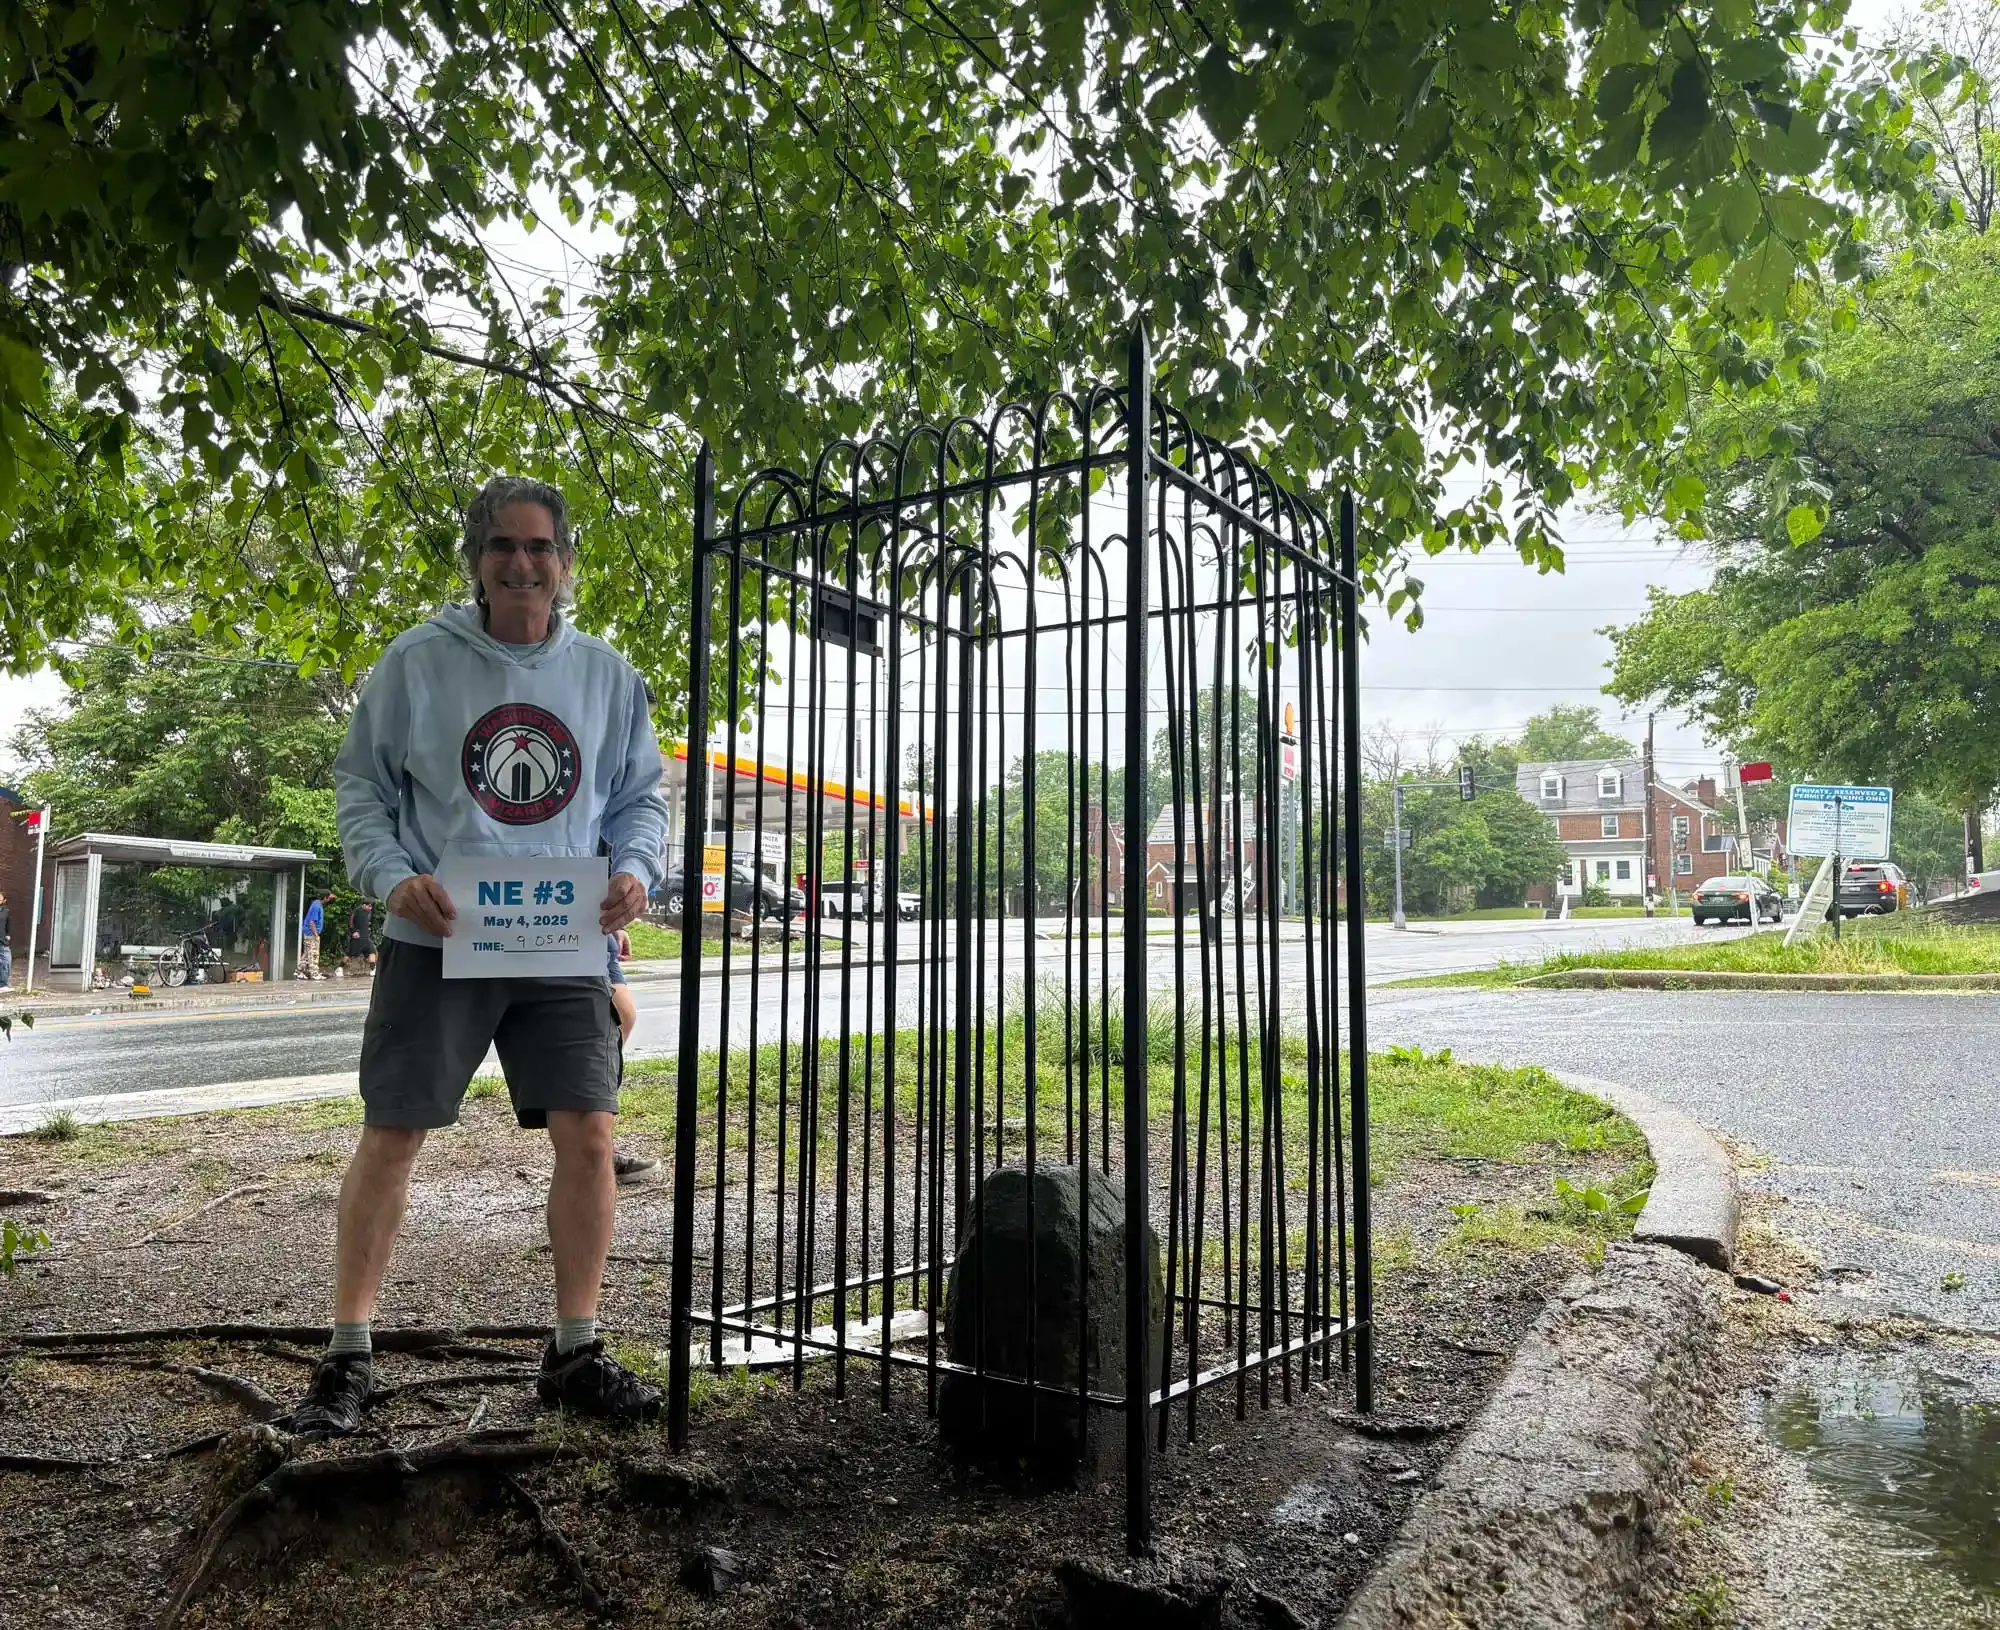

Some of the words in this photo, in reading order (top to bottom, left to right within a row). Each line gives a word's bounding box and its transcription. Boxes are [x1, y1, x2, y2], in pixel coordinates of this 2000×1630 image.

[1834, 788, 1878, 796] RESERVED
[478, 881, 524, 906] NE
[533, 880, 575, 906] #3
[483, 916, 513, 929] May
[516, 916, 530, 928] 4,
[533, 915, 569, 926] 2025
[472, 942, 504, 952] TIME:
